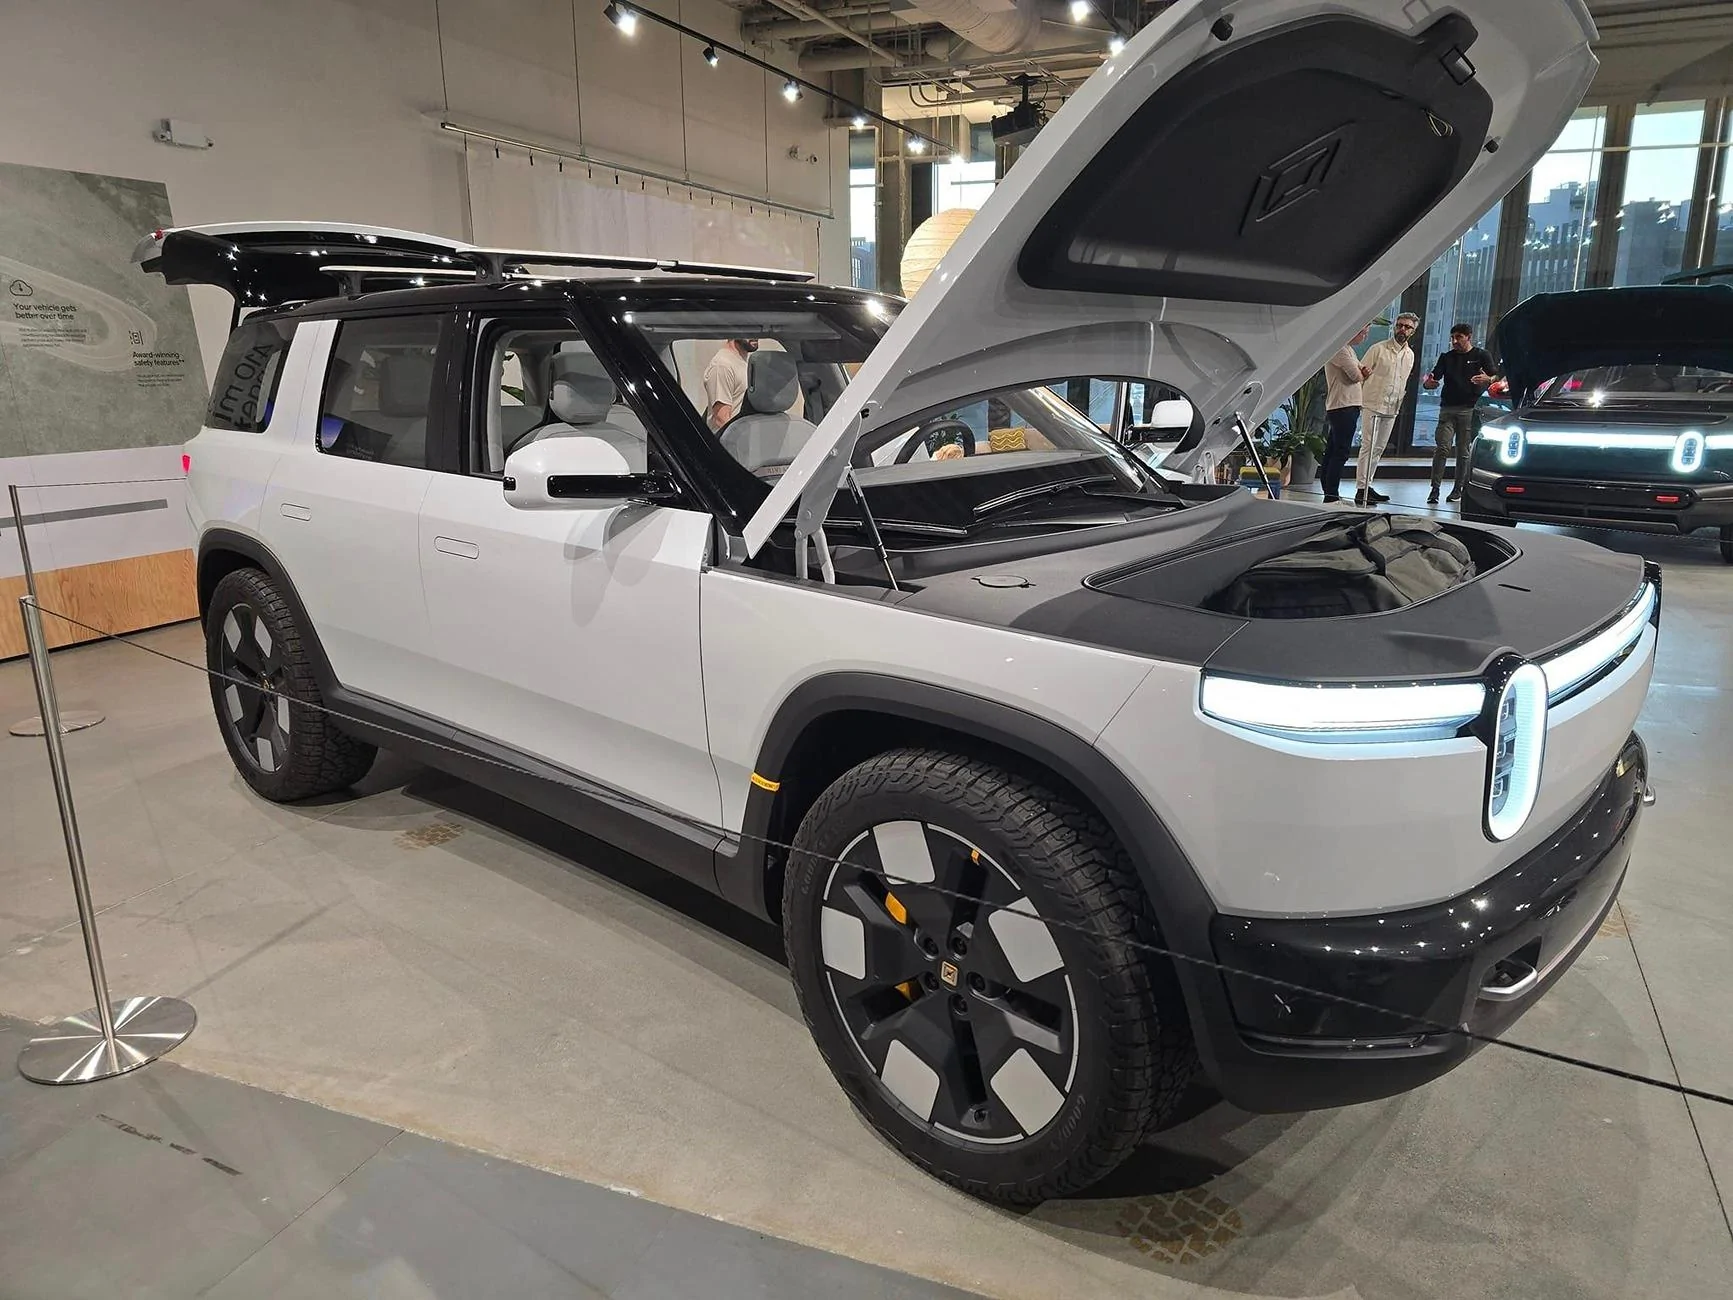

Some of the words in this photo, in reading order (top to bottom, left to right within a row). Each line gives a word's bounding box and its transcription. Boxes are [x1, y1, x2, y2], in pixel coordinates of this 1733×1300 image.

[12, 303, 32, 311] Your
[33, 303, 60, 312] vehicle
[60, 304, 78, 314] gets
[14, 312, 38, 320] better
[57, 312, 75, 320] time
[132, 351, 180, 359] Award-winning
[134, 359, 153, 368] safety
